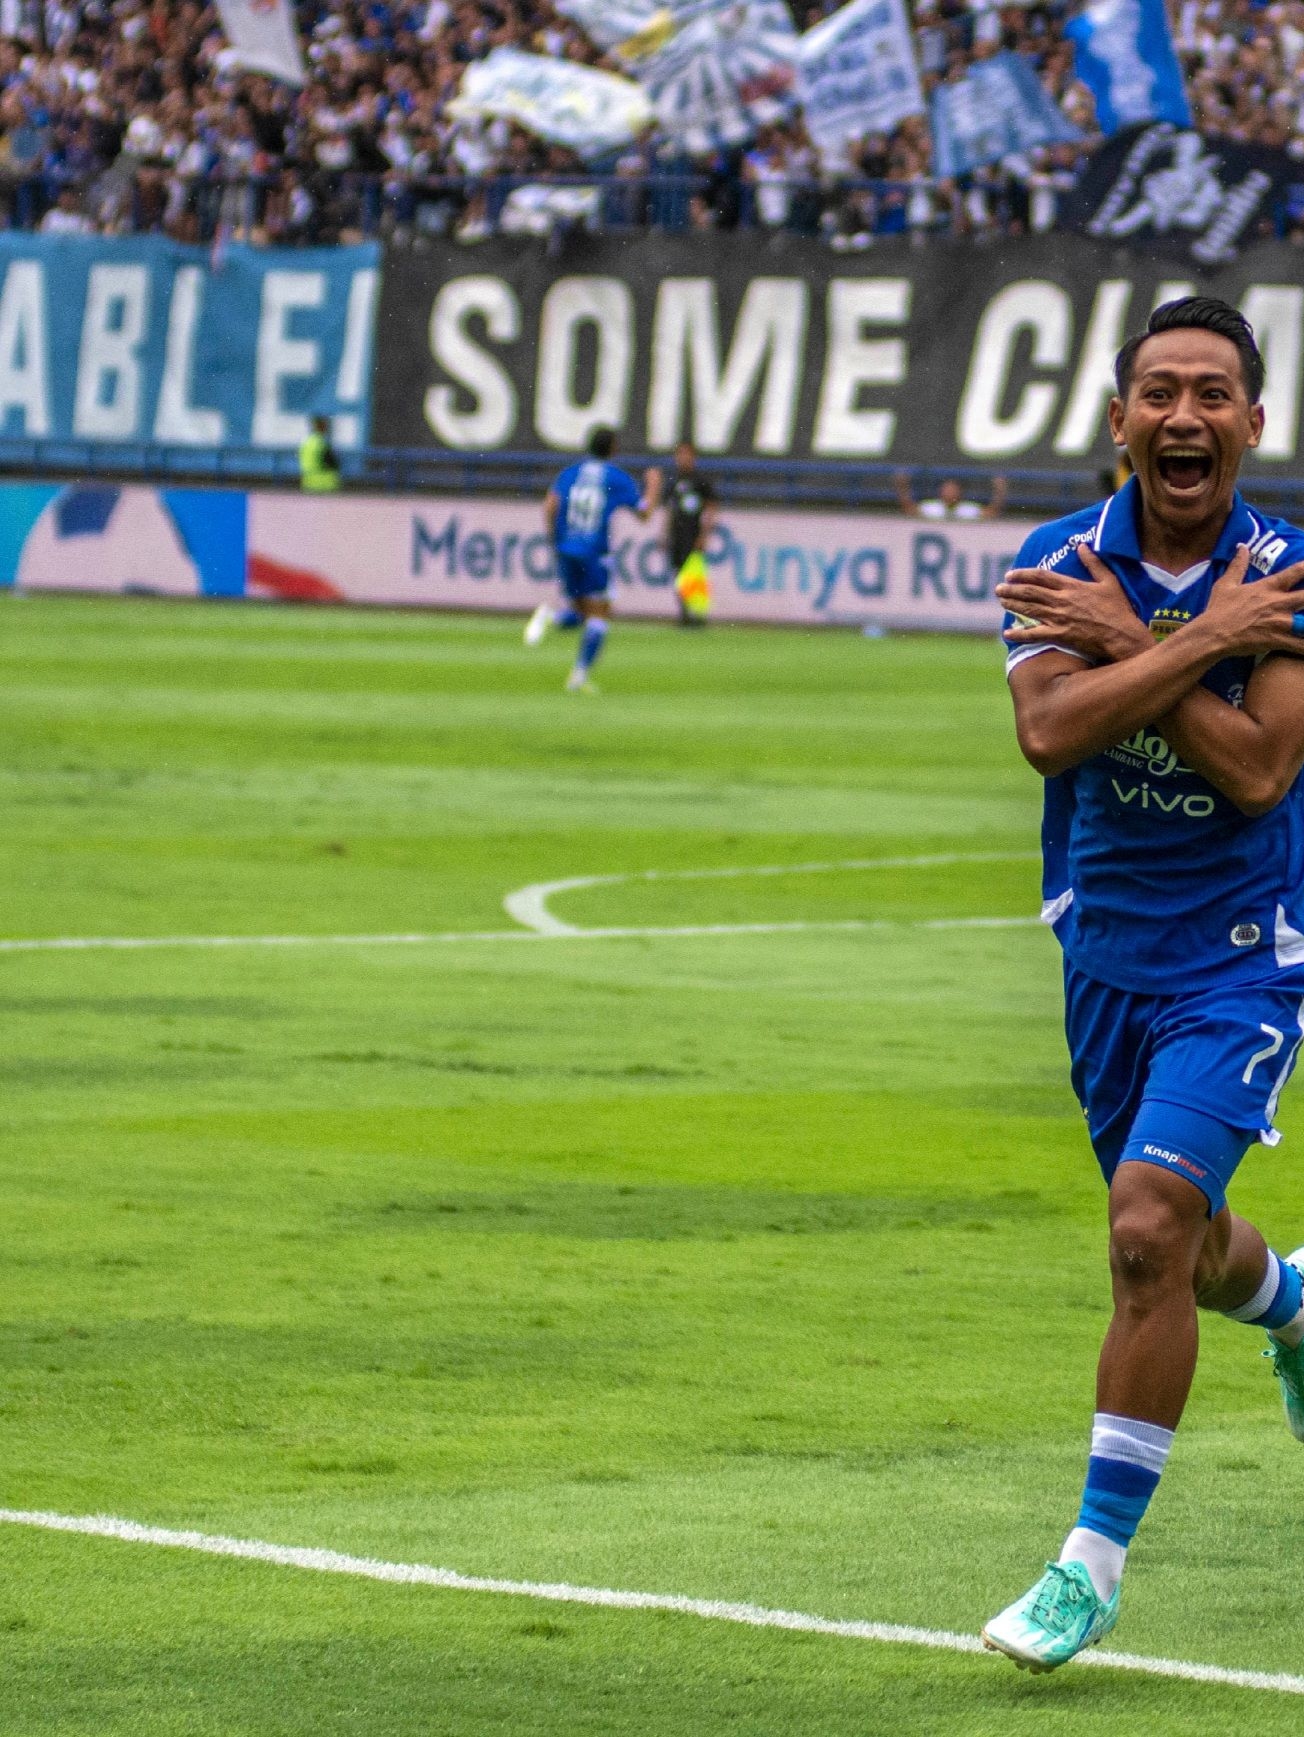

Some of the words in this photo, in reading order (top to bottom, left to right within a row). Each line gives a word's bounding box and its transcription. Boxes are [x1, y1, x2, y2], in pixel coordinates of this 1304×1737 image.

[423, 274, 913, 457] SOME
[1111, 778, 1215, 818] vivo
[1241, 1022, 1284, 1085] 7
